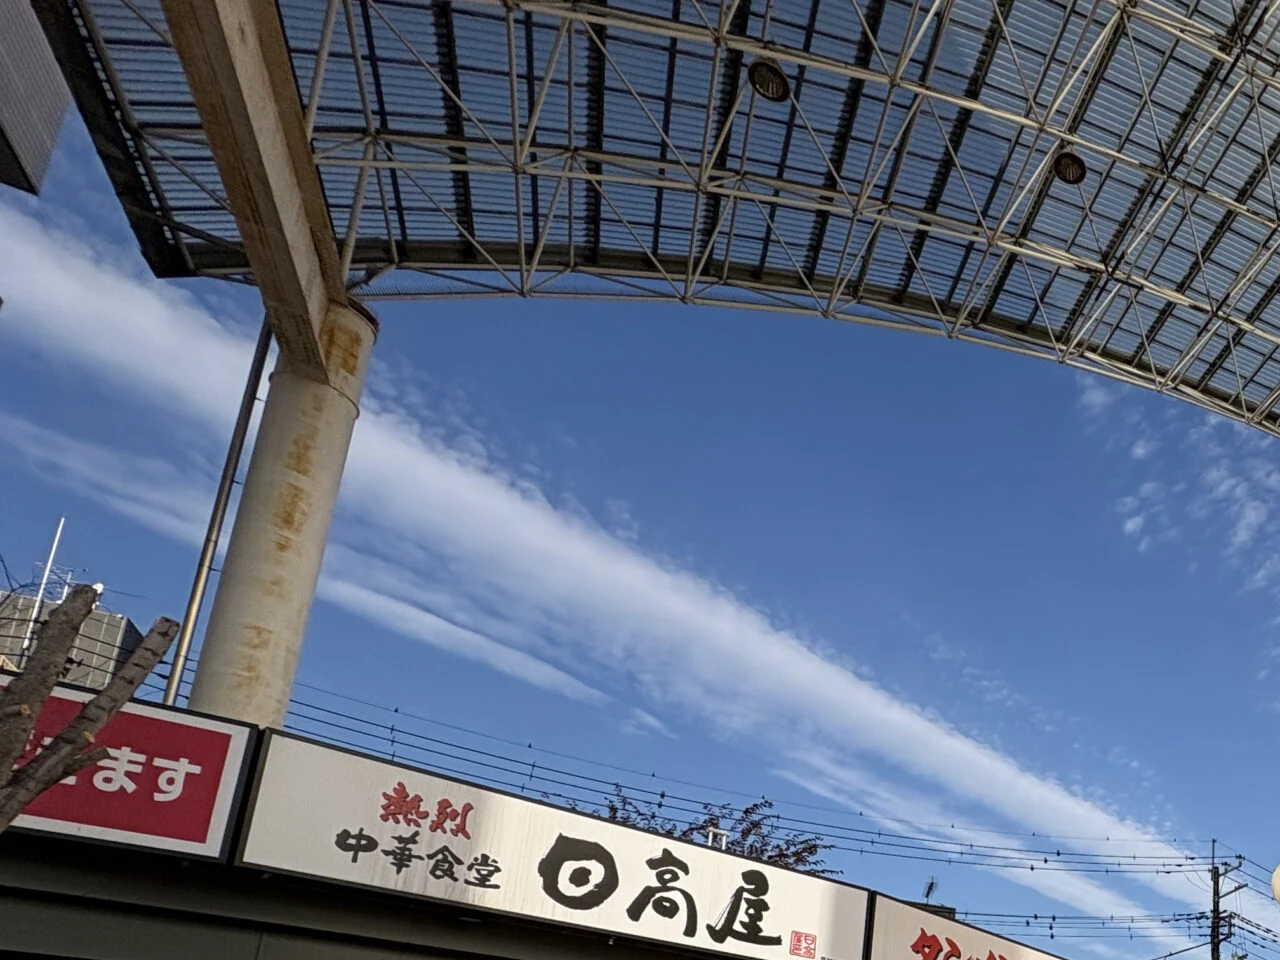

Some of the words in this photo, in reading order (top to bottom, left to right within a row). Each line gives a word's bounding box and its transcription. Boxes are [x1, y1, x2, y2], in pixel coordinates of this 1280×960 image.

[379, 780, 474, 841] 熱烈
[335, 826, 503, 891] 中華食堂
[537, 831, 783, 946] 日高屋
